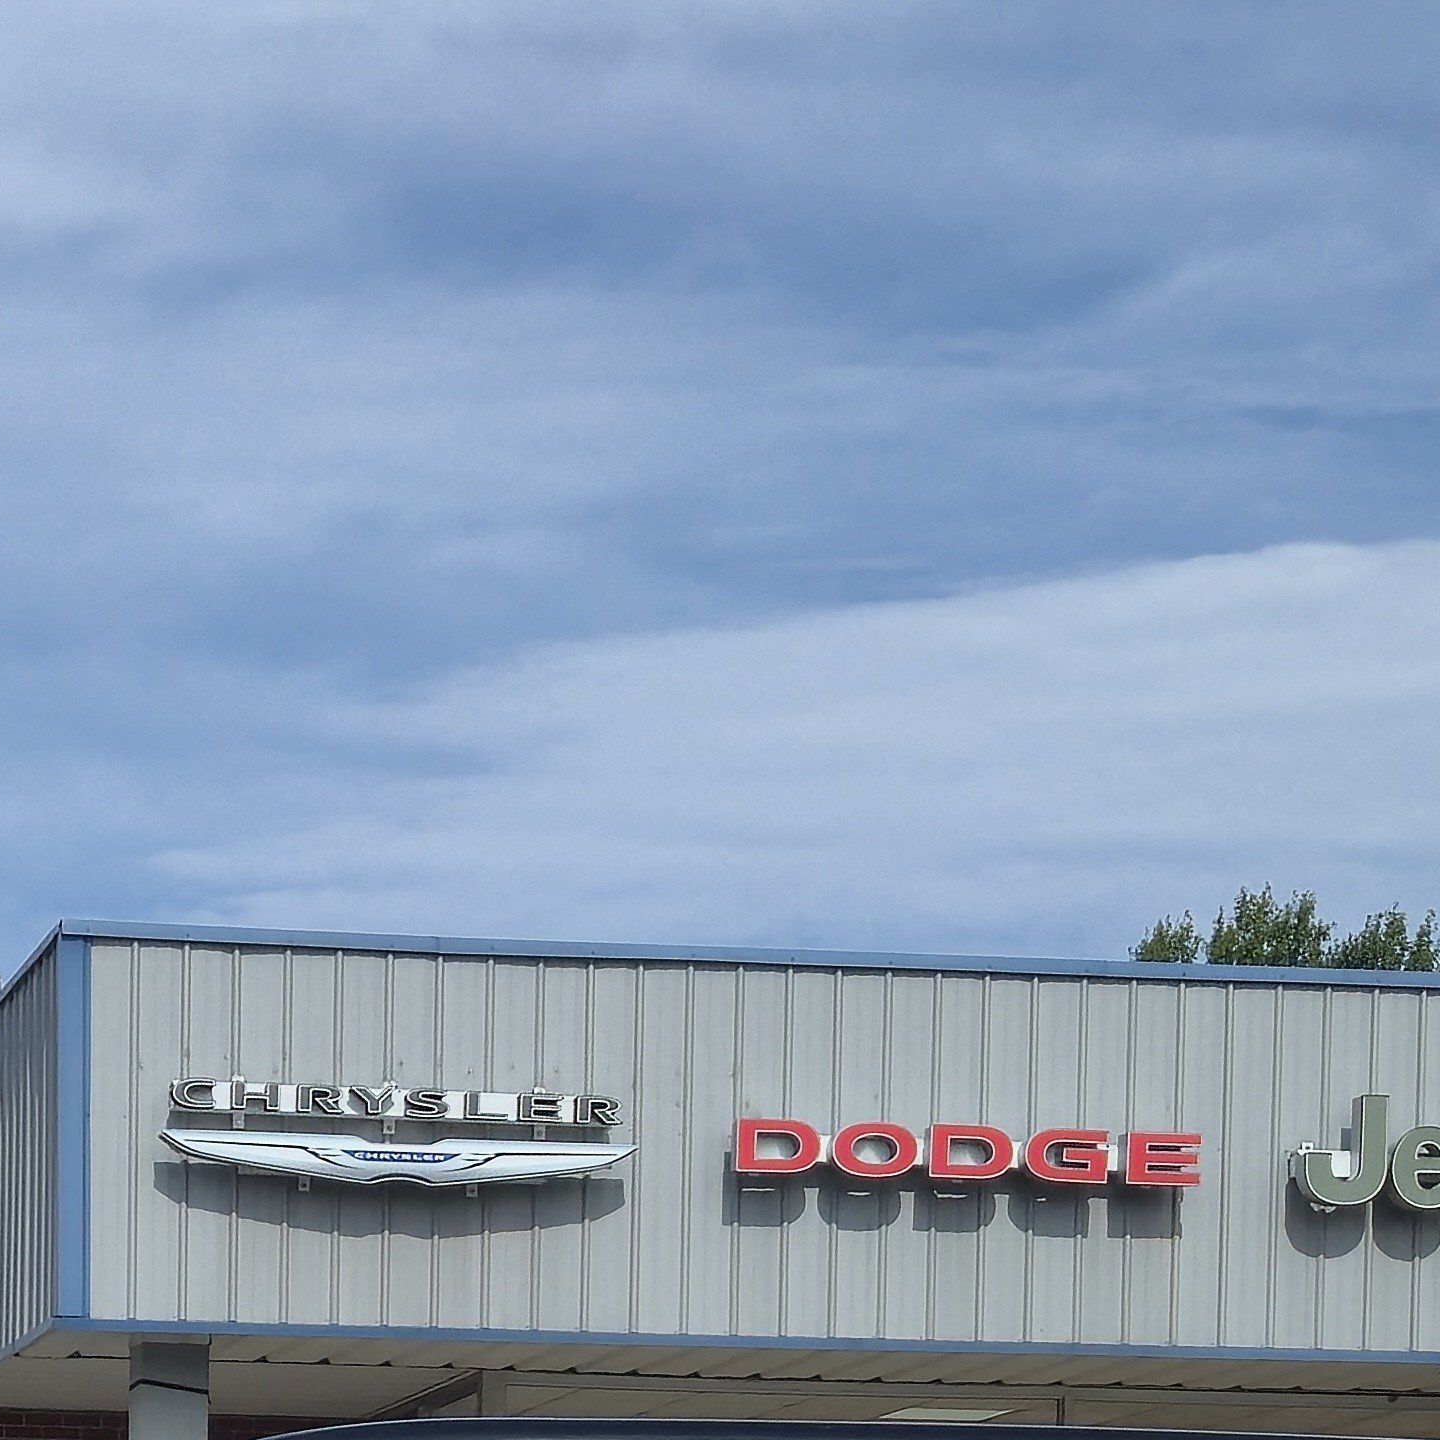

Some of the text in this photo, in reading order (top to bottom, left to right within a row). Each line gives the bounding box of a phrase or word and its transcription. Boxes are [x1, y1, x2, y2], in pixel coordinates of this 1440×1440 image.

[172, 1077, 624, 1125] CHRYSLER
[354, 1151, 445, 1162] CHRYSLER
[734, 1118, 1203, 1186] DODGE
